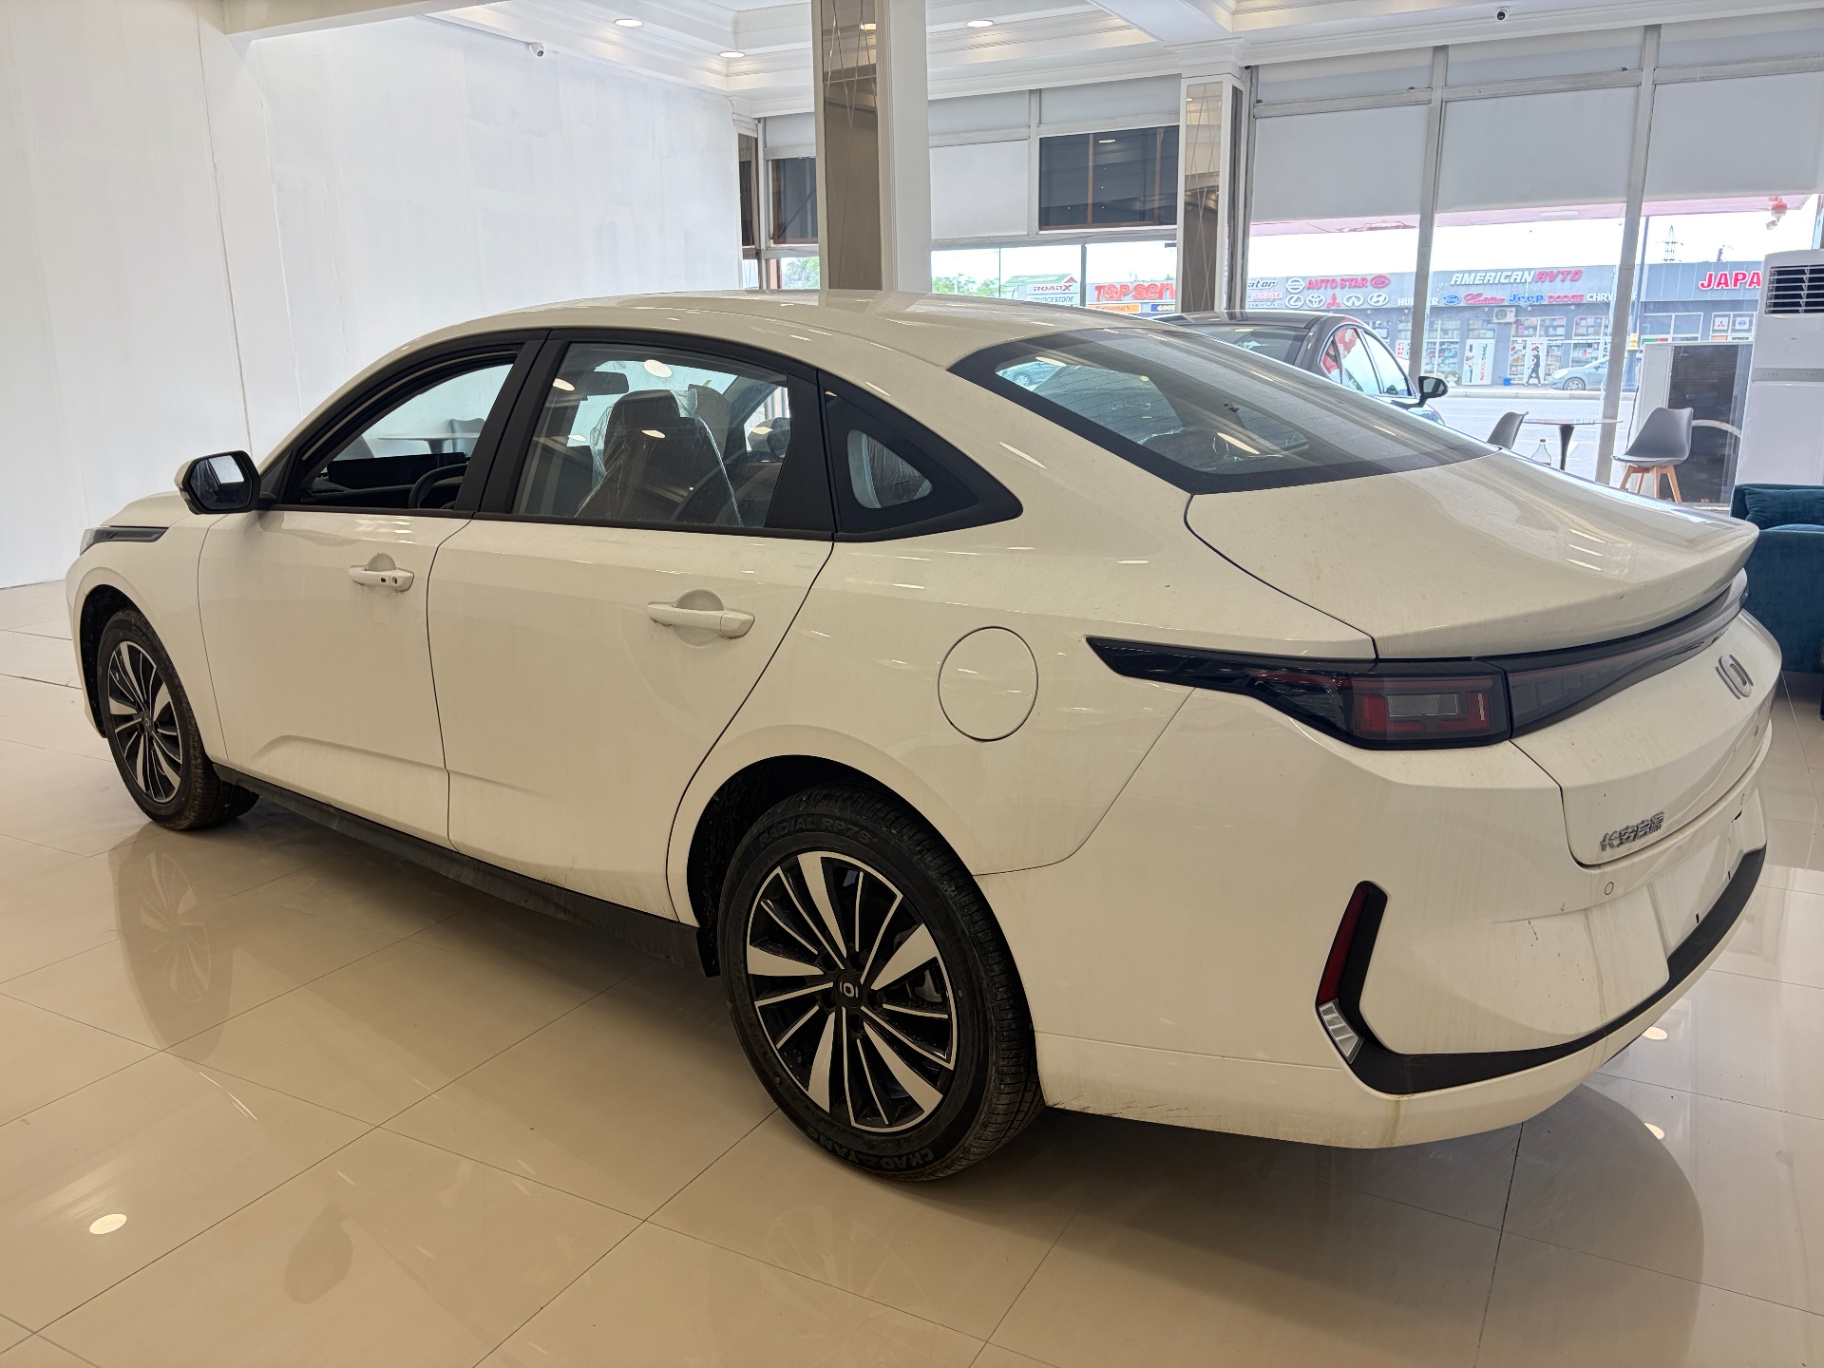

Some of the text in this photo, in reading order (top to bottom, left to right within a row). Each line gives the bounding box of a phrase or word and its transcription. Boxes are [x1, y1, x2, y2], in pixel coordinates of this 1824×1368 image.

[1306, 278, 1338, 290] AUTO
[1339, 277, 1368, 288] STAR
[1450, 269, 1583, 285] AMERICAN AVTO
[1699, 271, 1762, 290] JAPA
[1033, 284, 1073, 292] ROADX
[1094, 283, 1131, 302] TOP
[1508, 293, 1546, 305] Jeep
[1547, 294, 1585, 304] DODGE
[759, 817, 816, 848] RADIAL
[880, 1148, 934, 1169] CHAO
